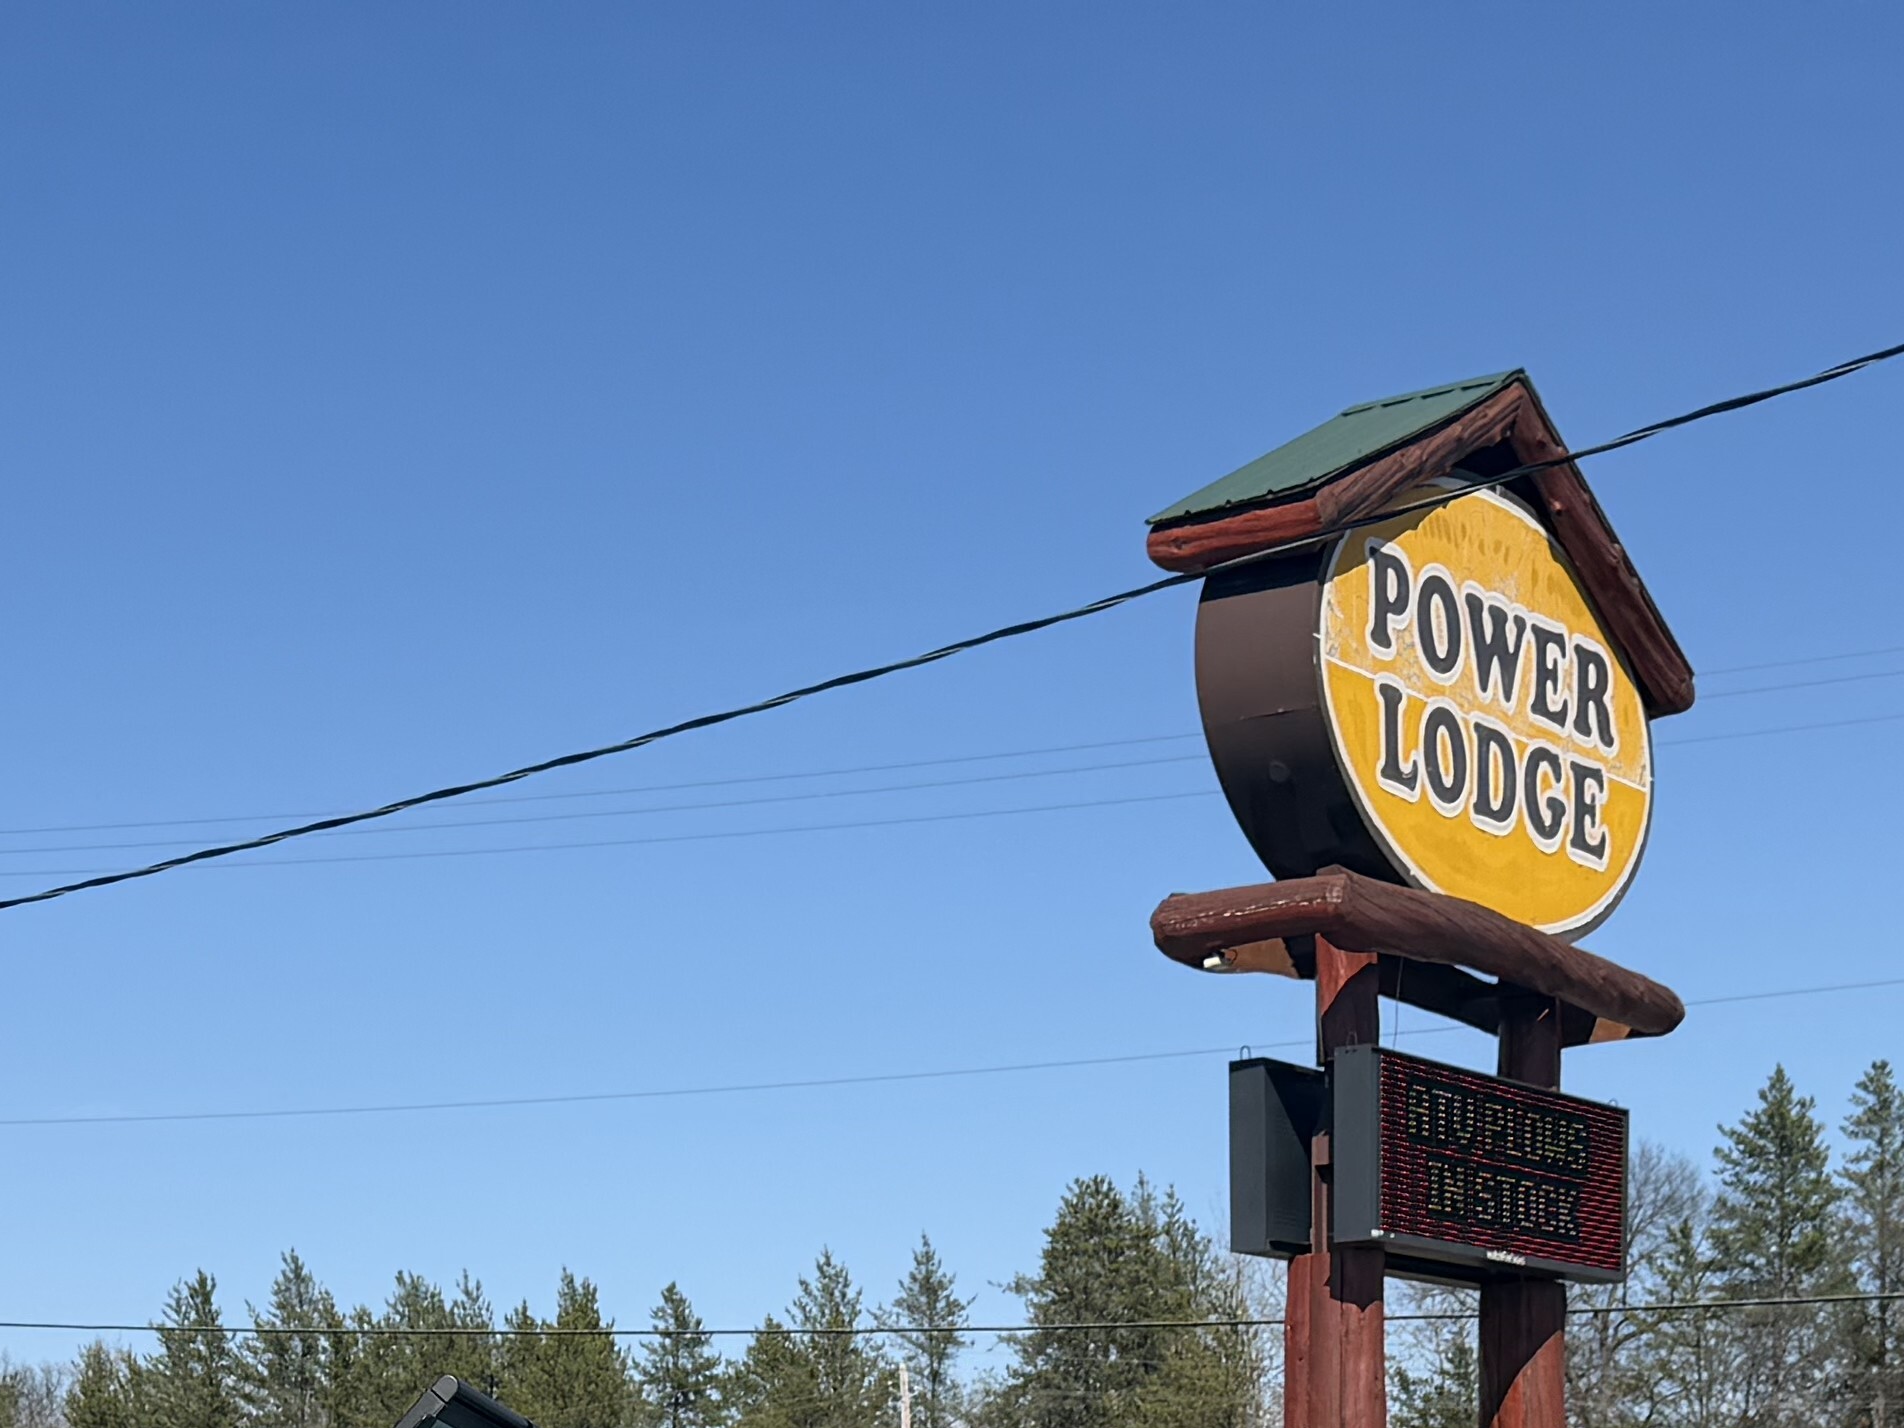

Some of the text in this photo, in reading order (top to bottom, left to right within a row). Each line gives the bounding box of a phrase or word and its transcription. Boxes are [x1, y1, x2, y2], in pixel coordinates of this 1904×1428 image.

[1368, 542, 1616, 753] POWER
[1377, 681, 1607, 864] LODGE
[1427, 1161, 1578, 1236] IN STOCK
[1485, 1103, 1587, 1170] PLOWS
